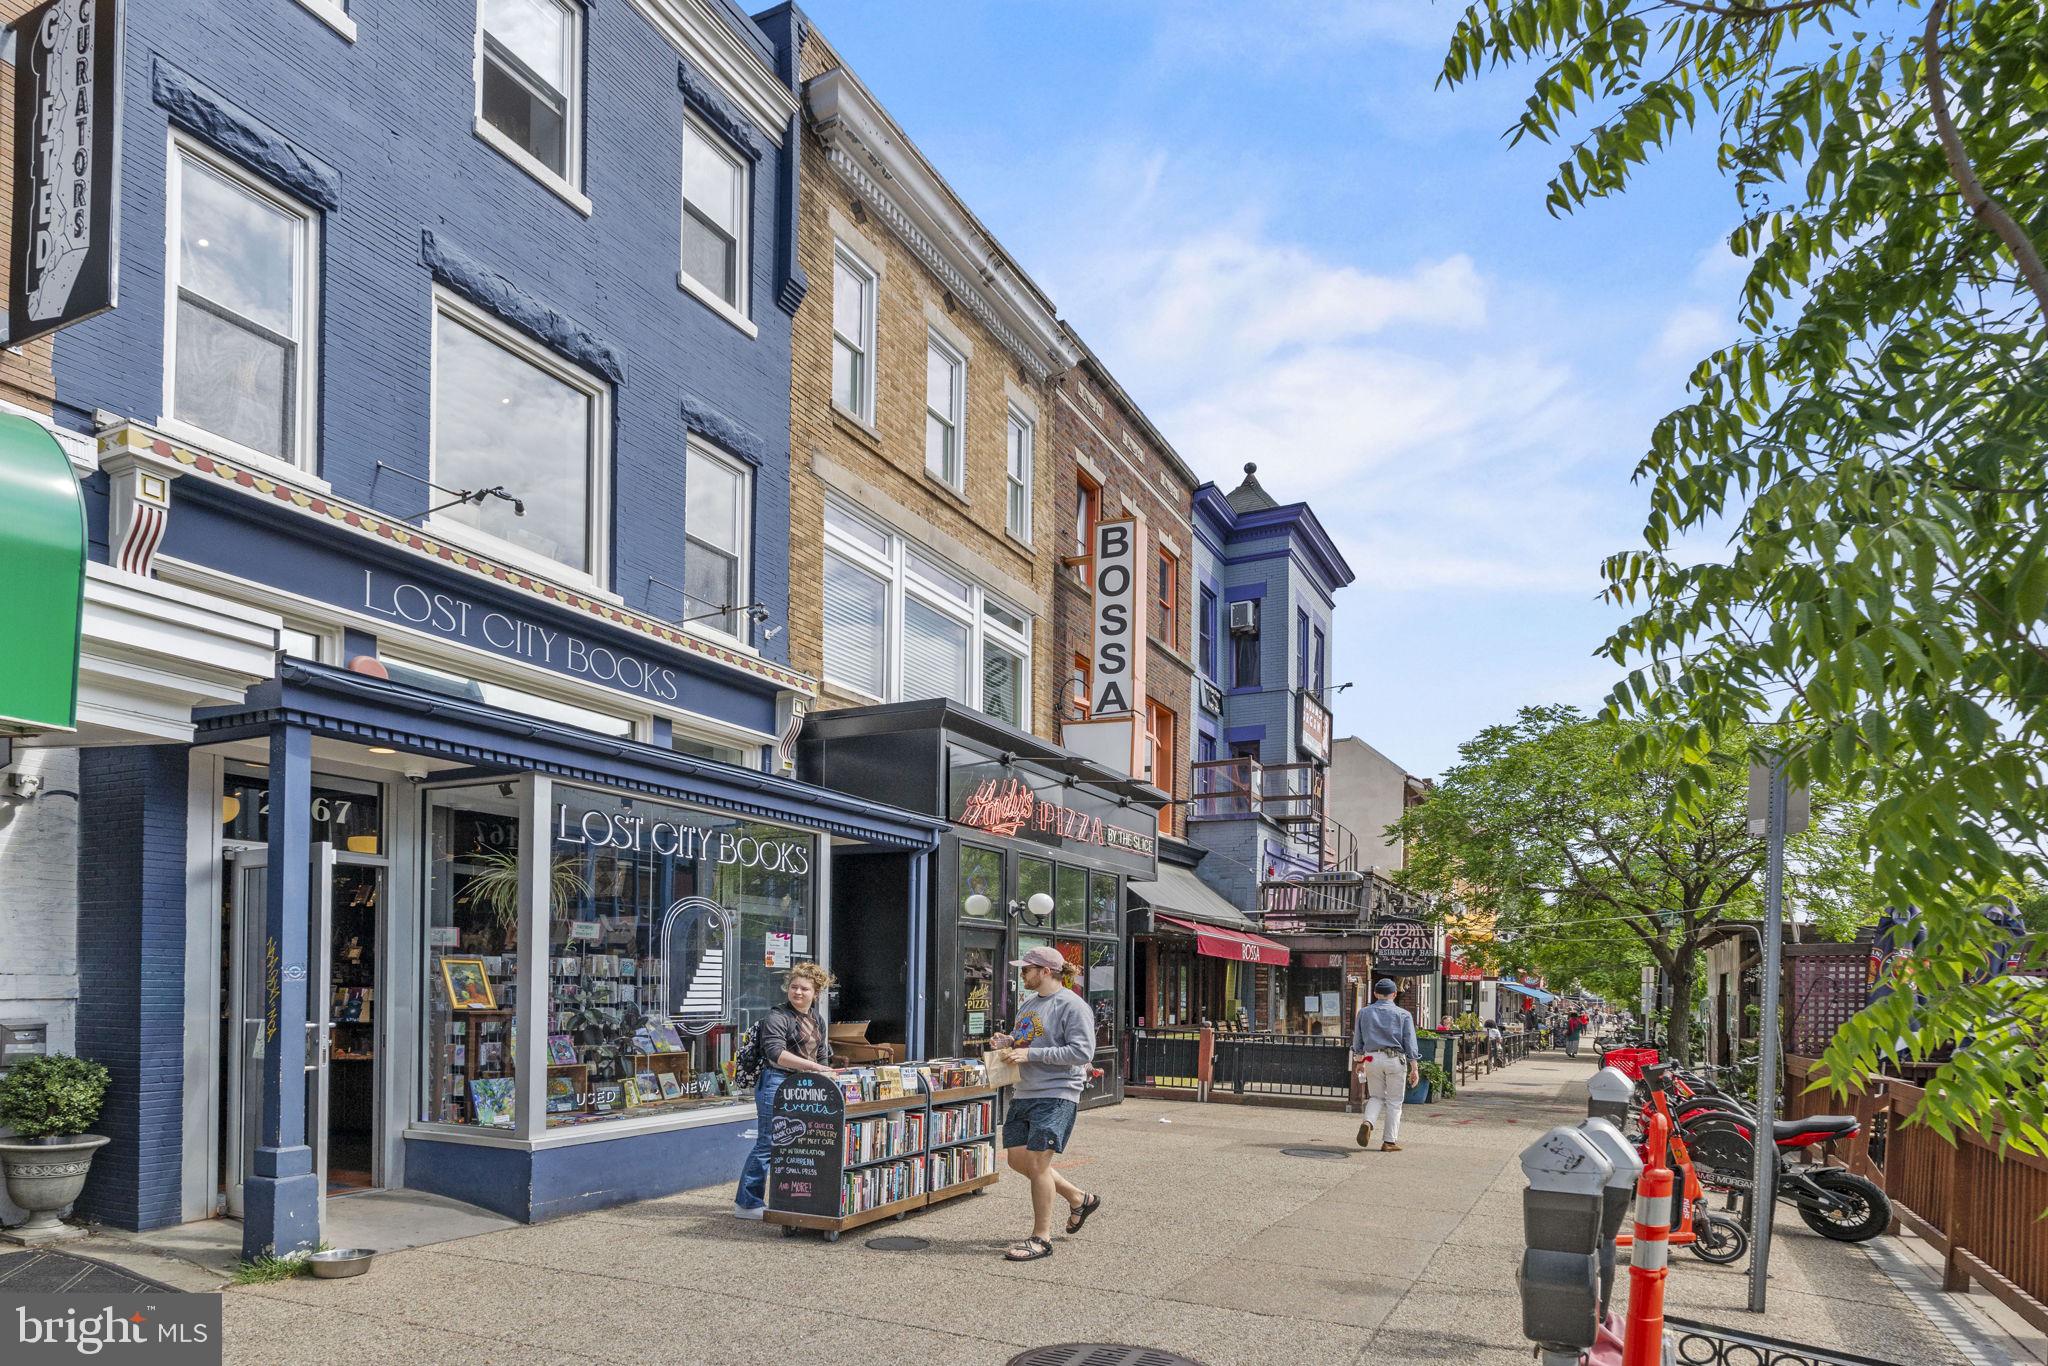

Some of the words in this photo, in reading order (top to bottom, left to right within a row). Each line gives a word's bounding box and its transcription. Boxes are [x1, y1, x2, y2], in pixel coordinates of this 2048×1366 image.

[74, 0, 91, 239] CURATORS
[36, 8, 59, 269] GIFTED
[1095, 526, 1131, 713] BOSSA
[364, 570, 472, 637] LOST
[483, 613, 558, 662] CITY
[567, 637, 677, 699] BOOKS
[1039, 801, 1104, 846] PIZZA
[1107, 828, 1117, 843] BY
[1118, 831, 1132, 846] THE
[1133, 835, 1153, 853] SLICE
[557, 804, 643, 850] LOST
[652, 822, 712, 860] CITY
[719, 833, 808, 874] BOOKS
[1379, 936, 1434, 949] ORGAN
[1242, 943, 1260, 961] BOSSA
[967, 1000, 990, 1009] PIZZA
[680, 1080, 711, 1095] NEW
[783, 1088, 828, 1101] UPCOMING
[576, 1090, 616, 1106] USED
[779, 1103, 838, 1114] events
[814, 1122, 835, 1131] QUEER
[816, 1130, 838, 1138] POETRY
[801, 1168, 817, 1176] PRESS
[1696, 1171, 1715, 1182] AMS
